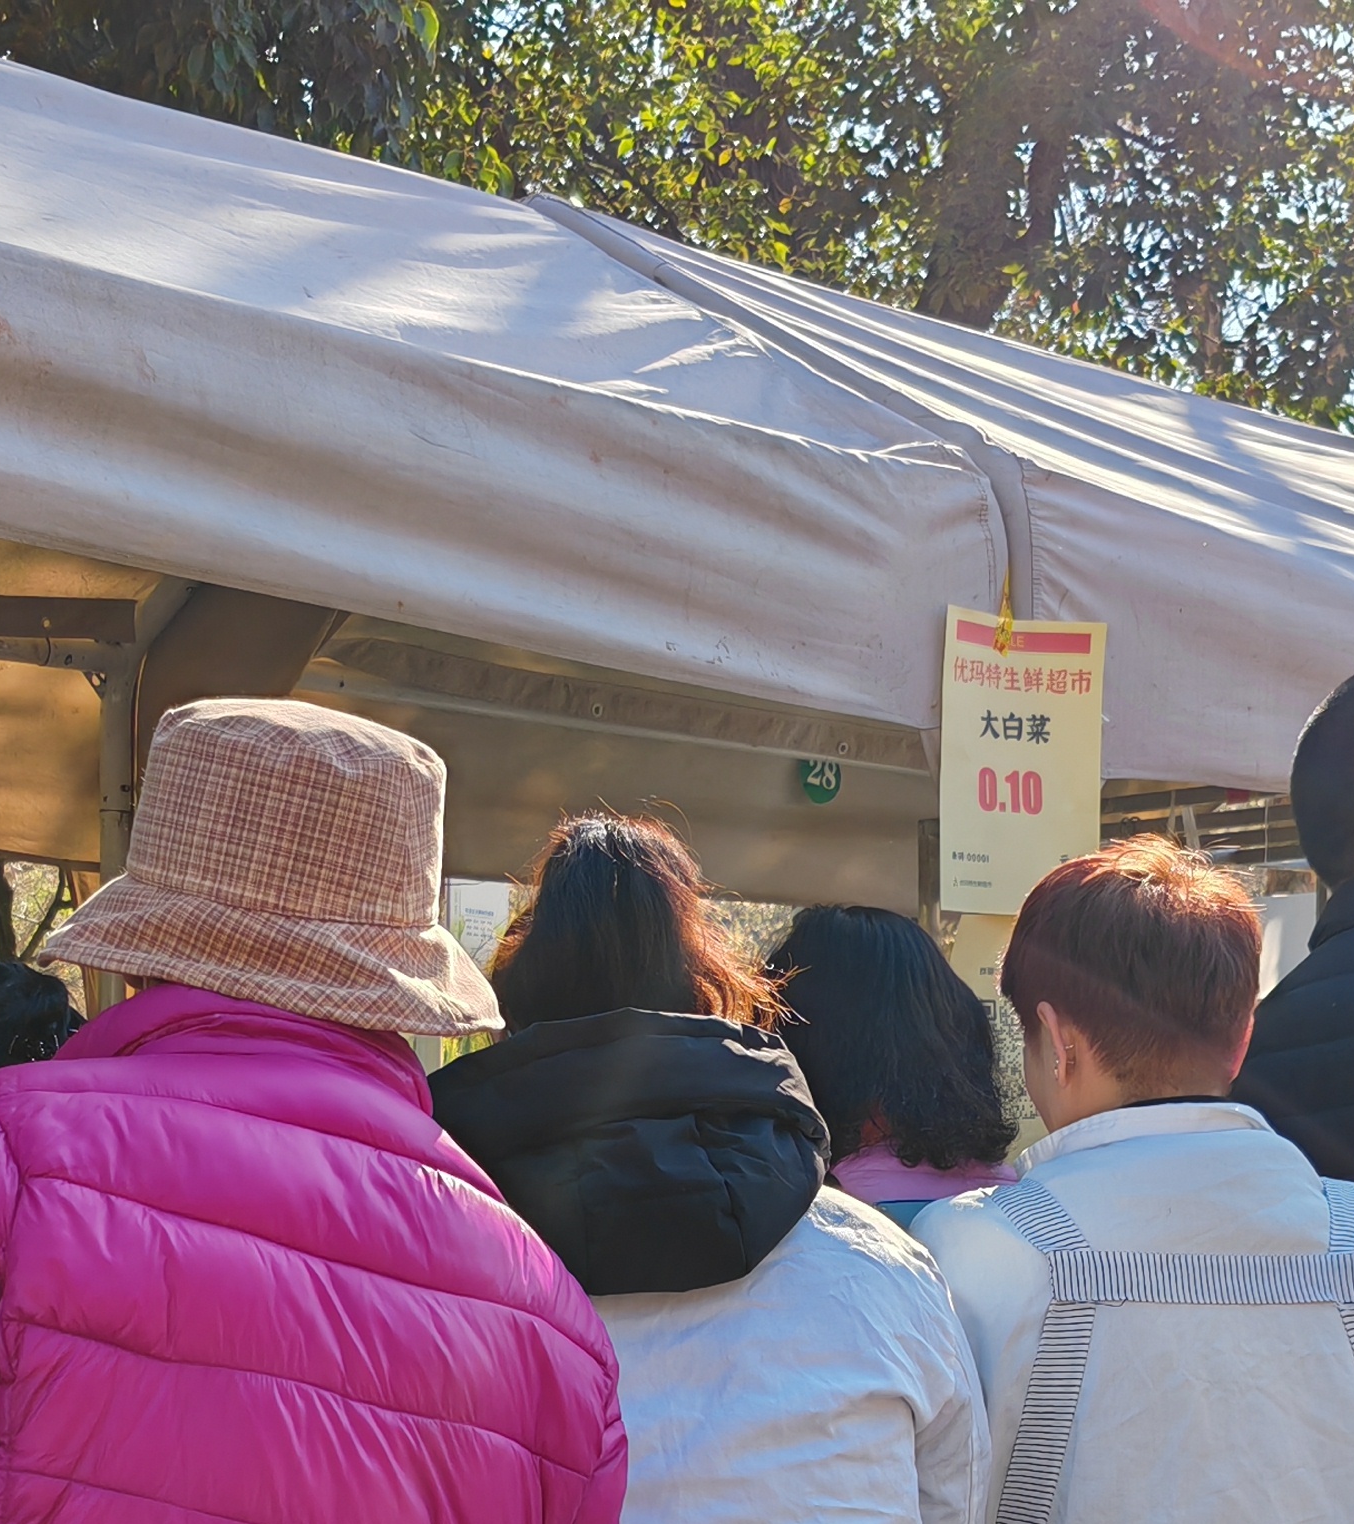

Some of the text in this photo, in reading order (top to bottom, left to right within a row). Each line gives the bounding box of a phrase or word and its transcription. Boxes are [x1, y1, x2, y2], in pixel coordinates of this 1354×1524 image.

[953, 656, 1092, 695] 优玛特生鲜超市
[980, 710, 1051, 744] 大白菜
[807, 760, 836, 790] 28
[978, 767, 1043, 815] 0.10
